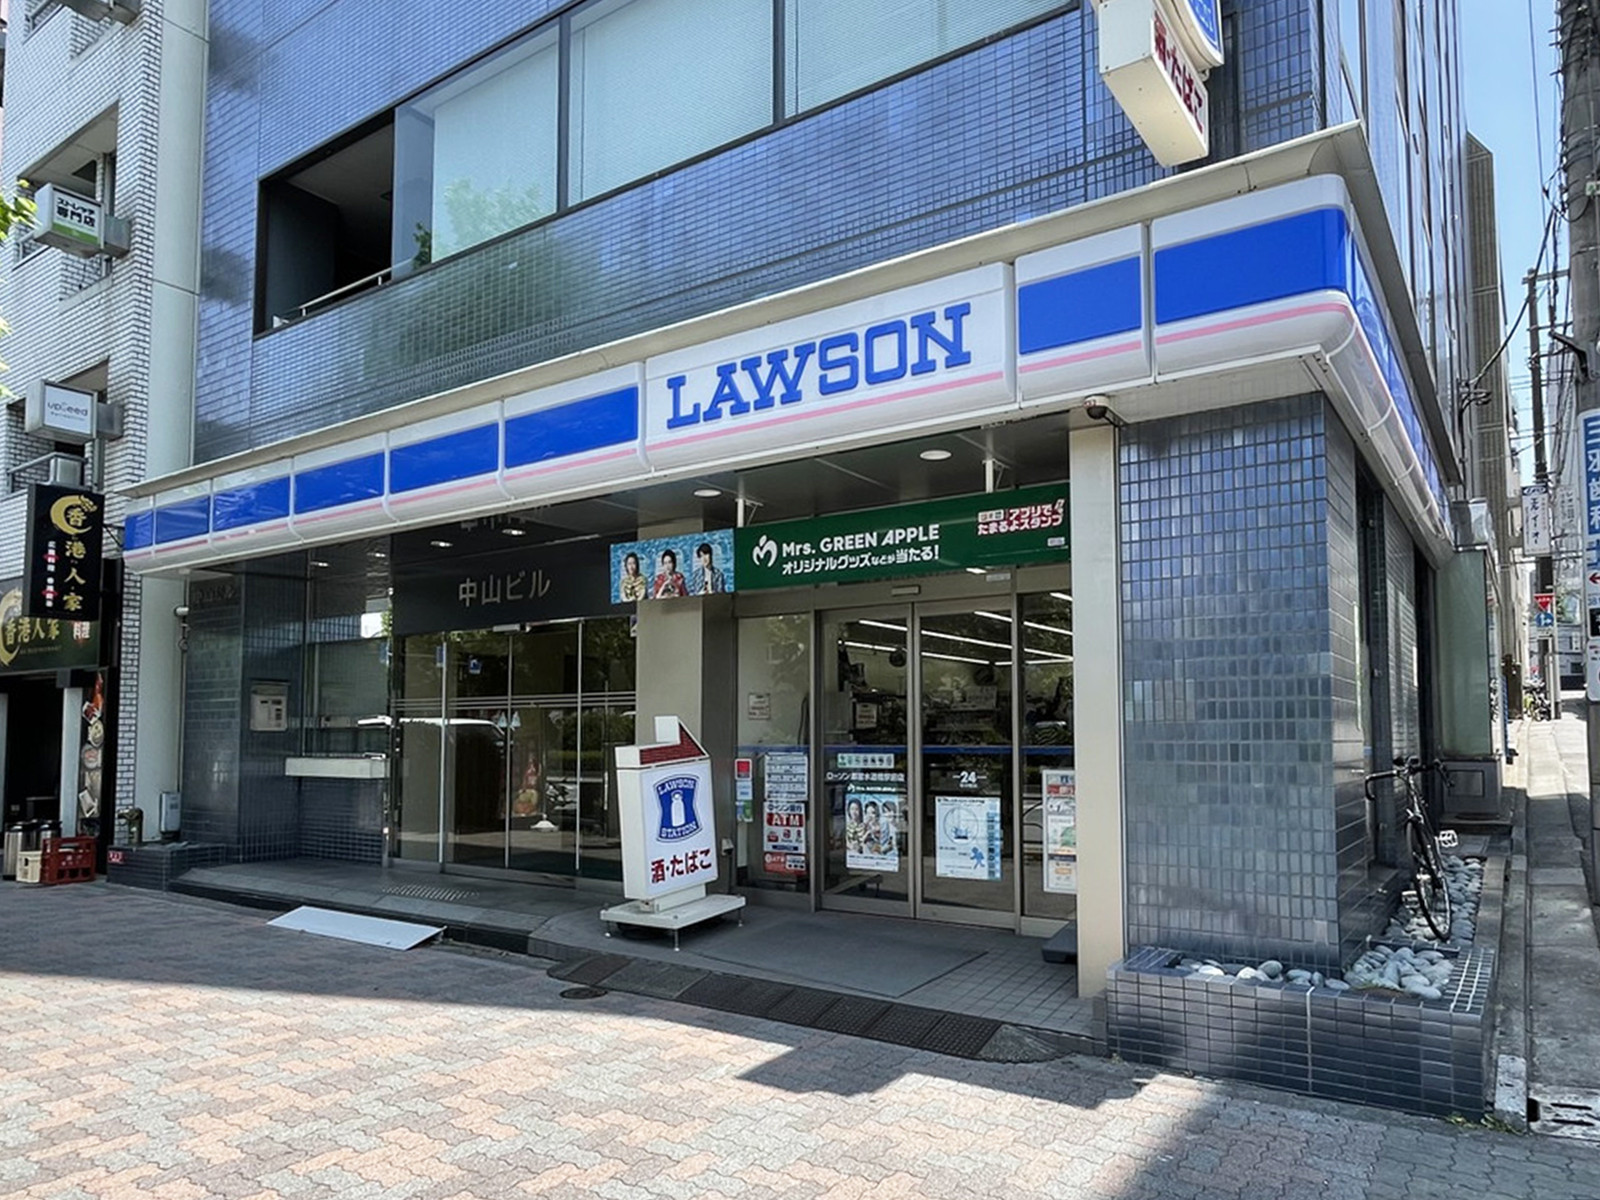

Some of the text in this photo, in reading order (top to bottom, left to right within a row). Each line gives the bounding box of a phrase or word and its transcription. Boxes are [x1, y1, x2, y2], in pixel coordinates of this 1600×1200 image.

[666, 302, 971, 430] LAWSON
[782, 523, 940, 557] Mrs. GREEN APPLE
[63, 507, 87, 612] 香港人家
[458, 569, 551, 608] 中山ビル
[658, 778, 696, 796] LAWSON
[960, 771, 977, 783] 24
[661, 819, 698, 839] STATION
[772, 813, 801, 827] ATM
[650, 848, 712, 884] 酒・たばこ
